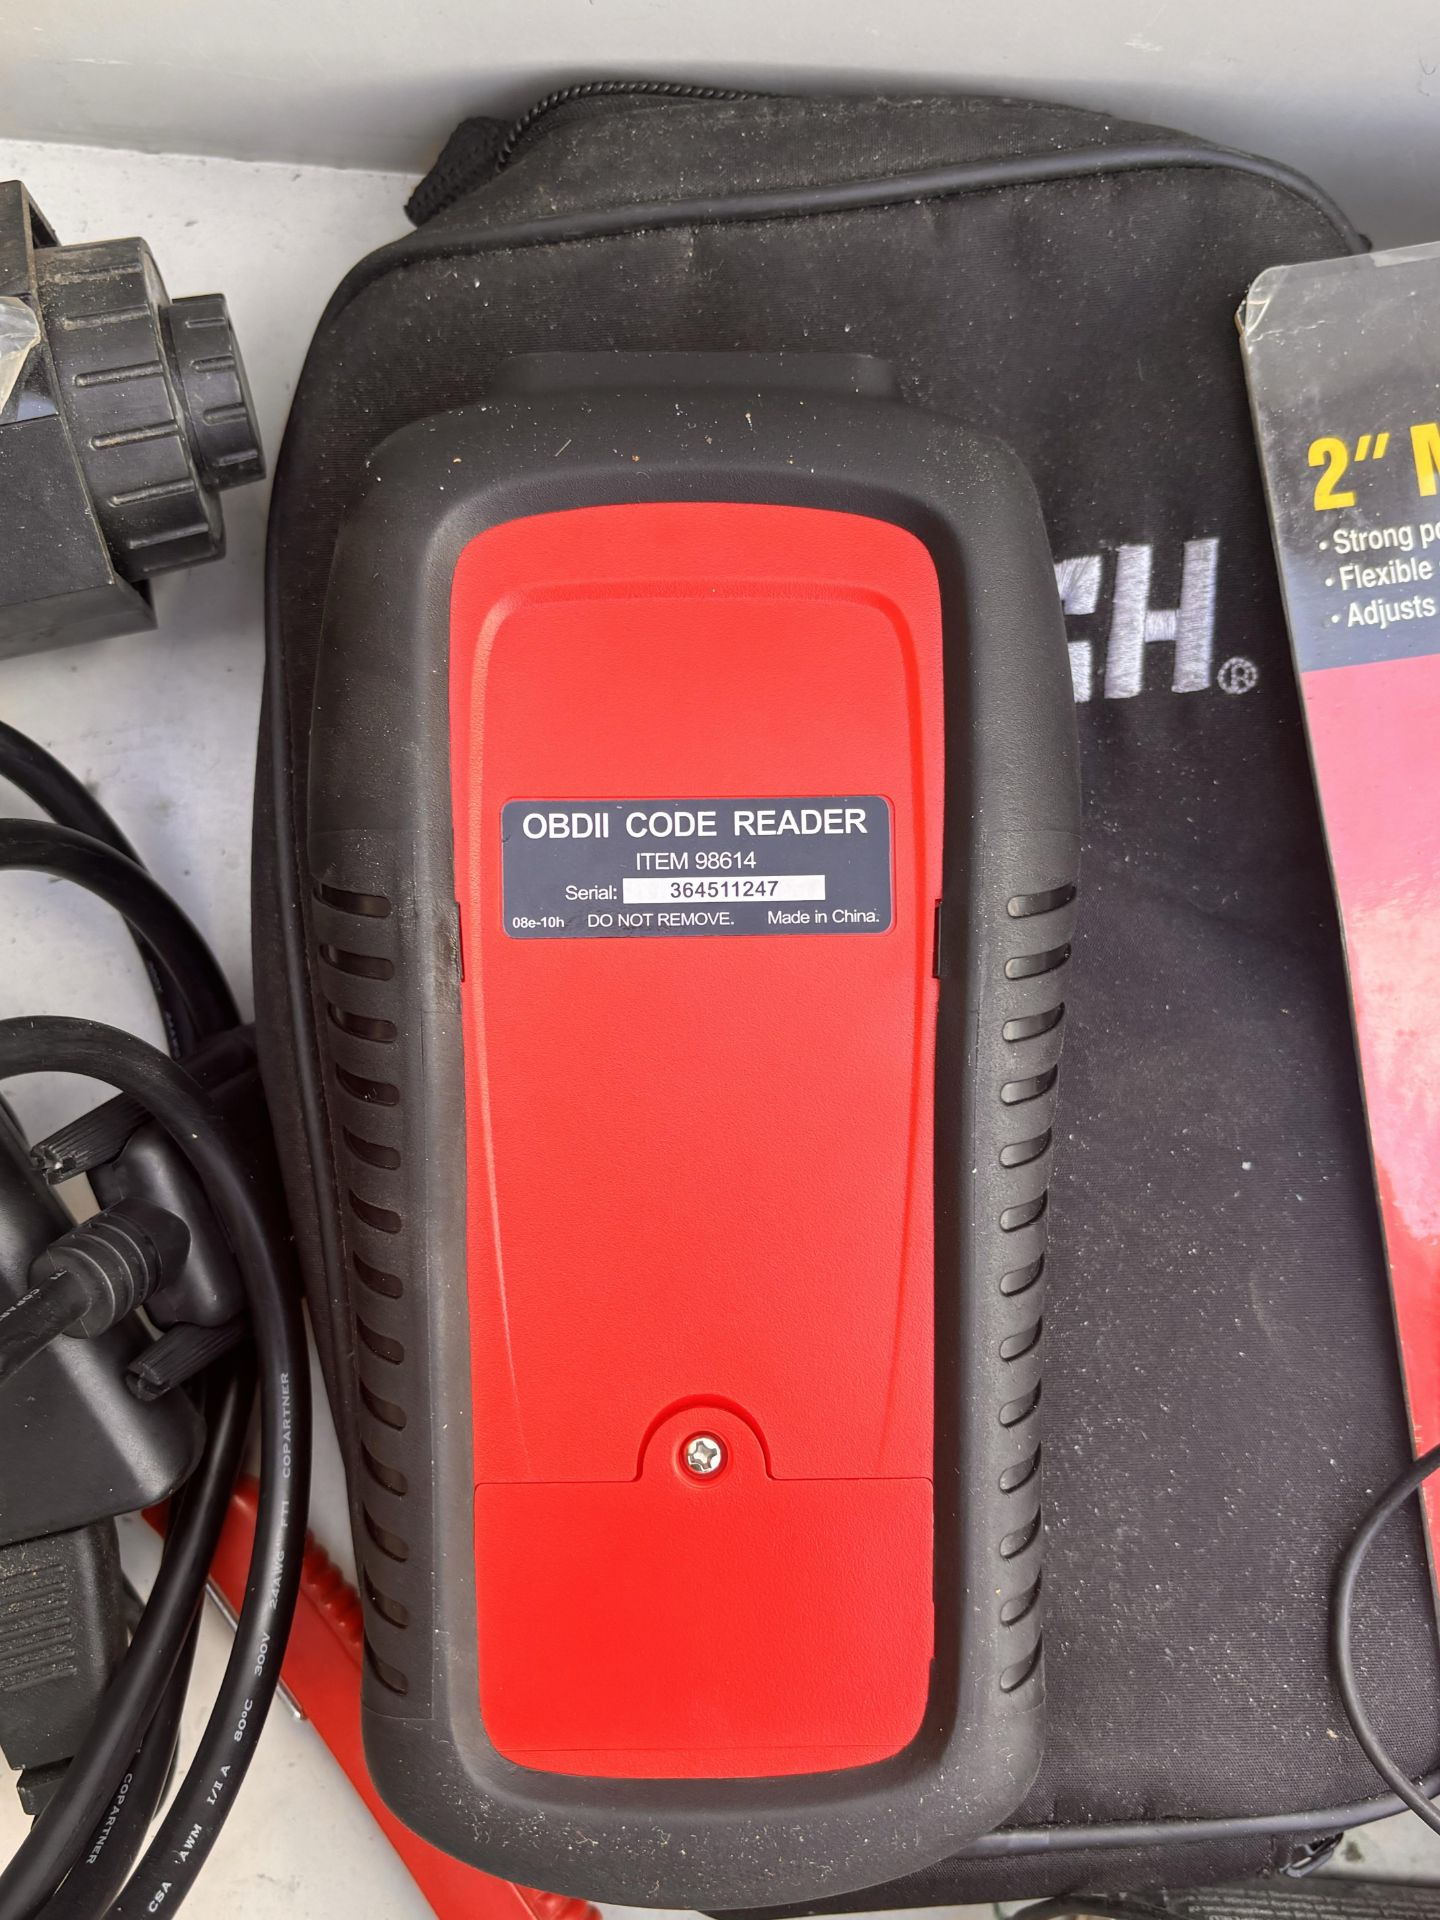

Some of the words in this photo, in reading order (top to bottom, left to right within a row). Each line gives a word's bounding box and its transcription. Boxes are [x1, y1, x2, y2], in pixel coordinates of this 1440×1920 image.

[1332, 525, 1414, 554] Strong
[1339, 557, 1433, 591] Flexible
[1347, 595, 1437, 630] Adjusts
[522, 812, 609, 839] OBDII
[625, 811, 718, 838] CODE
[733, 808, 869, 836] READER
[636, 852, 689, 871] ITEM
[695, 851, 757, 870] 98614
[565, 885, 618, 901] Serial:
[670, 880, 779, 898] 364511247
[512, 917, 565, 929] 08e-10h
[587, 914, 613, 928] DO
[618, 913, 653, 927] NOT
[657, 912, 735, 927] REMOVE.
[767, 910, 811, 925] Made
[814, 909, 828, 924] in
[832, 908, 880, 923] China.
[146, 1880, 173, 1913] CSA
[179, 1823, 203, 1862] AWM
[254, 1631, 271, 1677] 300V
[280, 1371, 292, 1479] COPARTNER
[86, 1772, 134, 1865] COPARTNER
